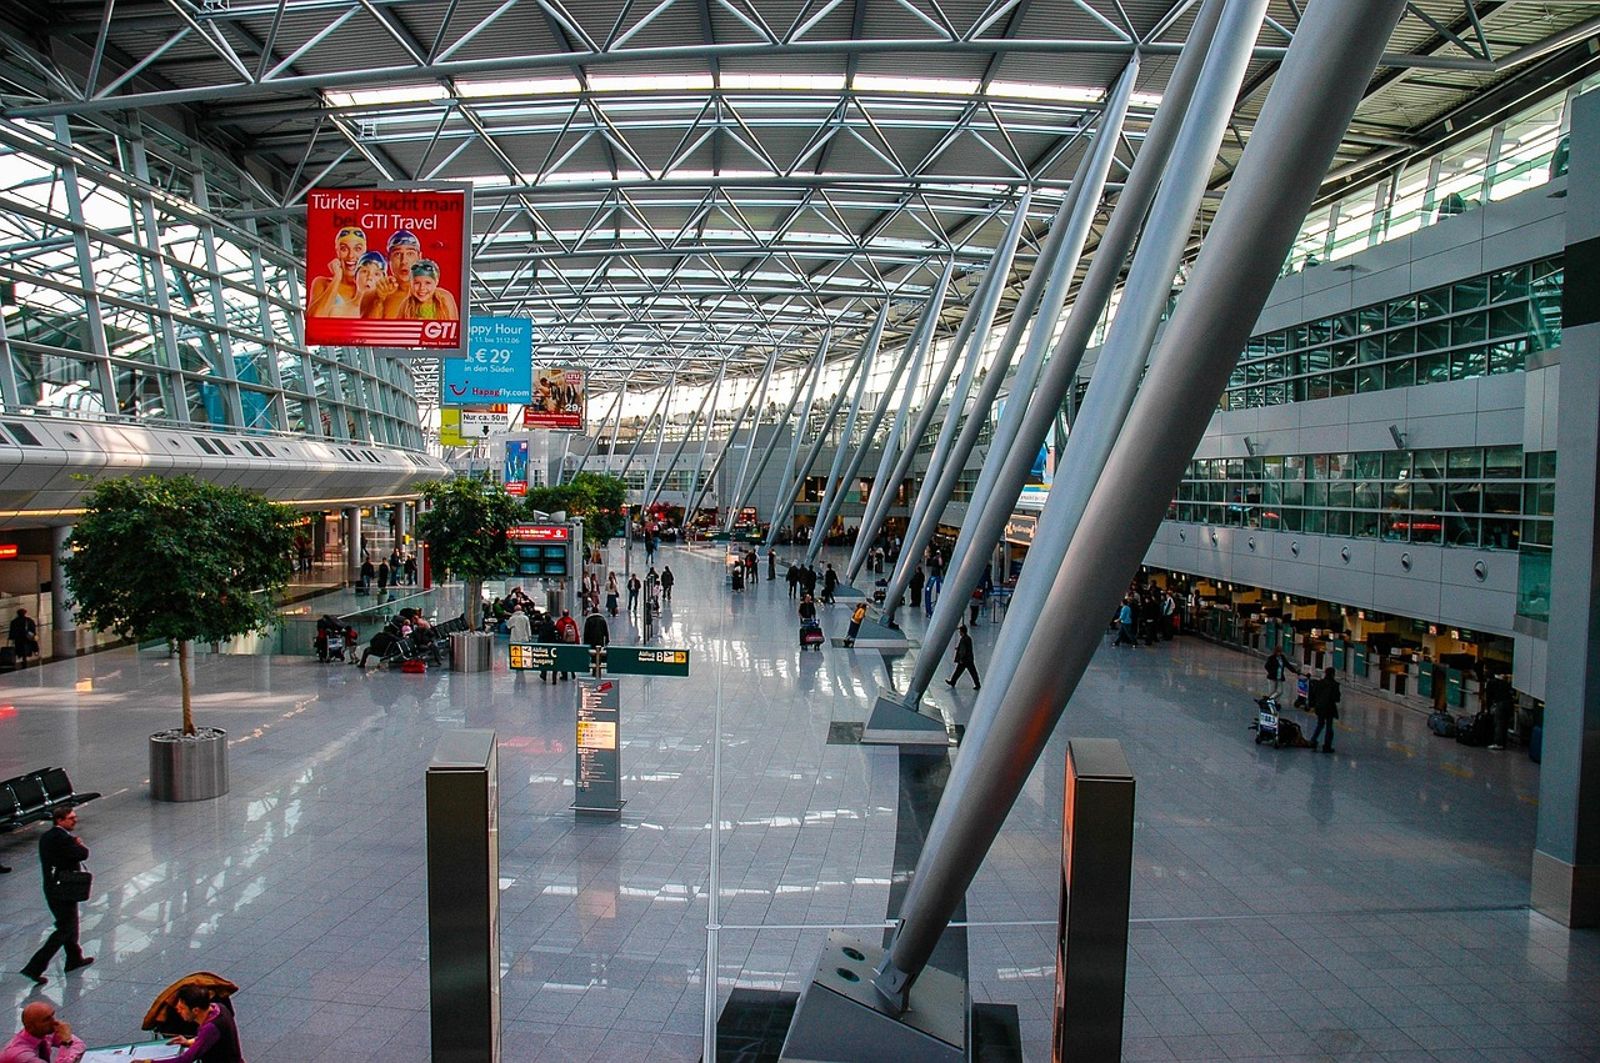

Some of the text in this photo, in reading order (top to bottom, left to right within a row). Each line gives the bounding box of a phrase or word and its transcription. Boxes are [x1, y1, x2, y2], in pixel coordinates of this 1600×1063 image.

[311, 193, 360, 210] Türkei
[372, 197, 418, 211] bucht
[423, 199, 460, 212] man
[333, 212, 437, 230] bei GTI Travel
[469, 323, 523, 336] ppy Hour
[475, 348, 488, 363] €
[473, 364, 488, 372] den
[490, 364, 514, 373] Süden
[463, 413, 477, 421] Nur
[550, 647, 557, 658] C
[655, 651, 663, 662] B
